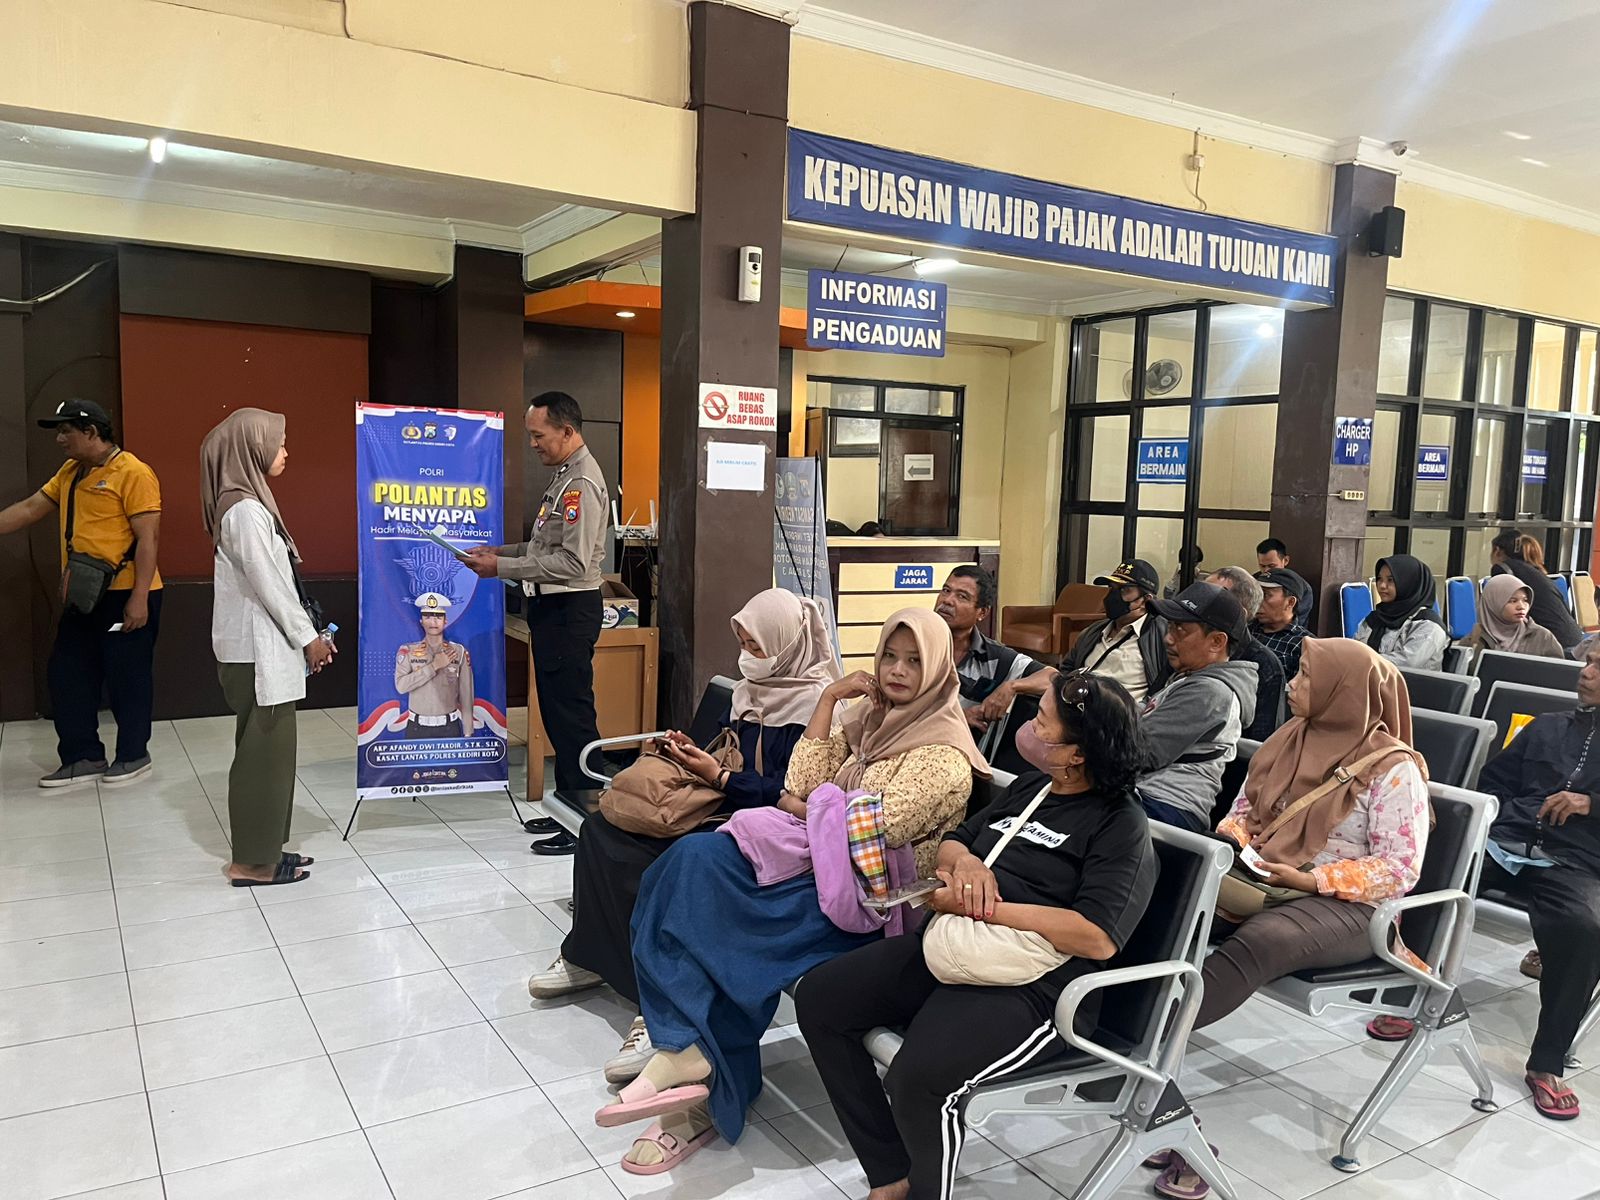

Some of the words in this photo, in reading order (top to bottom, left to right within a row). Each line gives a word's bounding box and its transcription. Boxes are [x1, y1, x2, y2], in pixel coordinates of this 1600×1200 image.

[804, 155, 952, 225] KEPUASAN
[958, 187, 1039, 240] WAJIB
[1045, 204, 1117, 253] PAJAK
[1120, 217, 1203, 267] ADALAH
[1207, 233, 1280, 280] TUJUAN
[1282, 247, 1331, 288] KAMI
[821, 277, 936, 310] INFORMASI
[812, 317, 942, 350] PENGADUAN
[738, 391, 765, 403] RUANG
[738, 403, 764, 414] BEBAS
[726, 414, 747, 425] ASAP
[749, 415, 775, 427] ROKOK
[1336, 425, 1371, 440] CHARGER
[1147, 446, 1179, 458] AREA
[1345, 443, 1359, 457] HP
[1424, 452, 1441, 463] AREA
[419, 467, 444, 477] POLRI
[1139, 463, 1186, 476] BERMAIN
[374, 482, 487, 508] POLANTAS
[384, 505, 477, 524] MENYAPA
[370, 526, 395, 535] Hadir
[903, 569, 927, 577] JAGA
[900, 577, 928, 585] JARAK
[390, 744, 417, 752] AFANDY
[401, 753, 428, 761] LANTAS
[482, 750, 499, 758] KOTA
